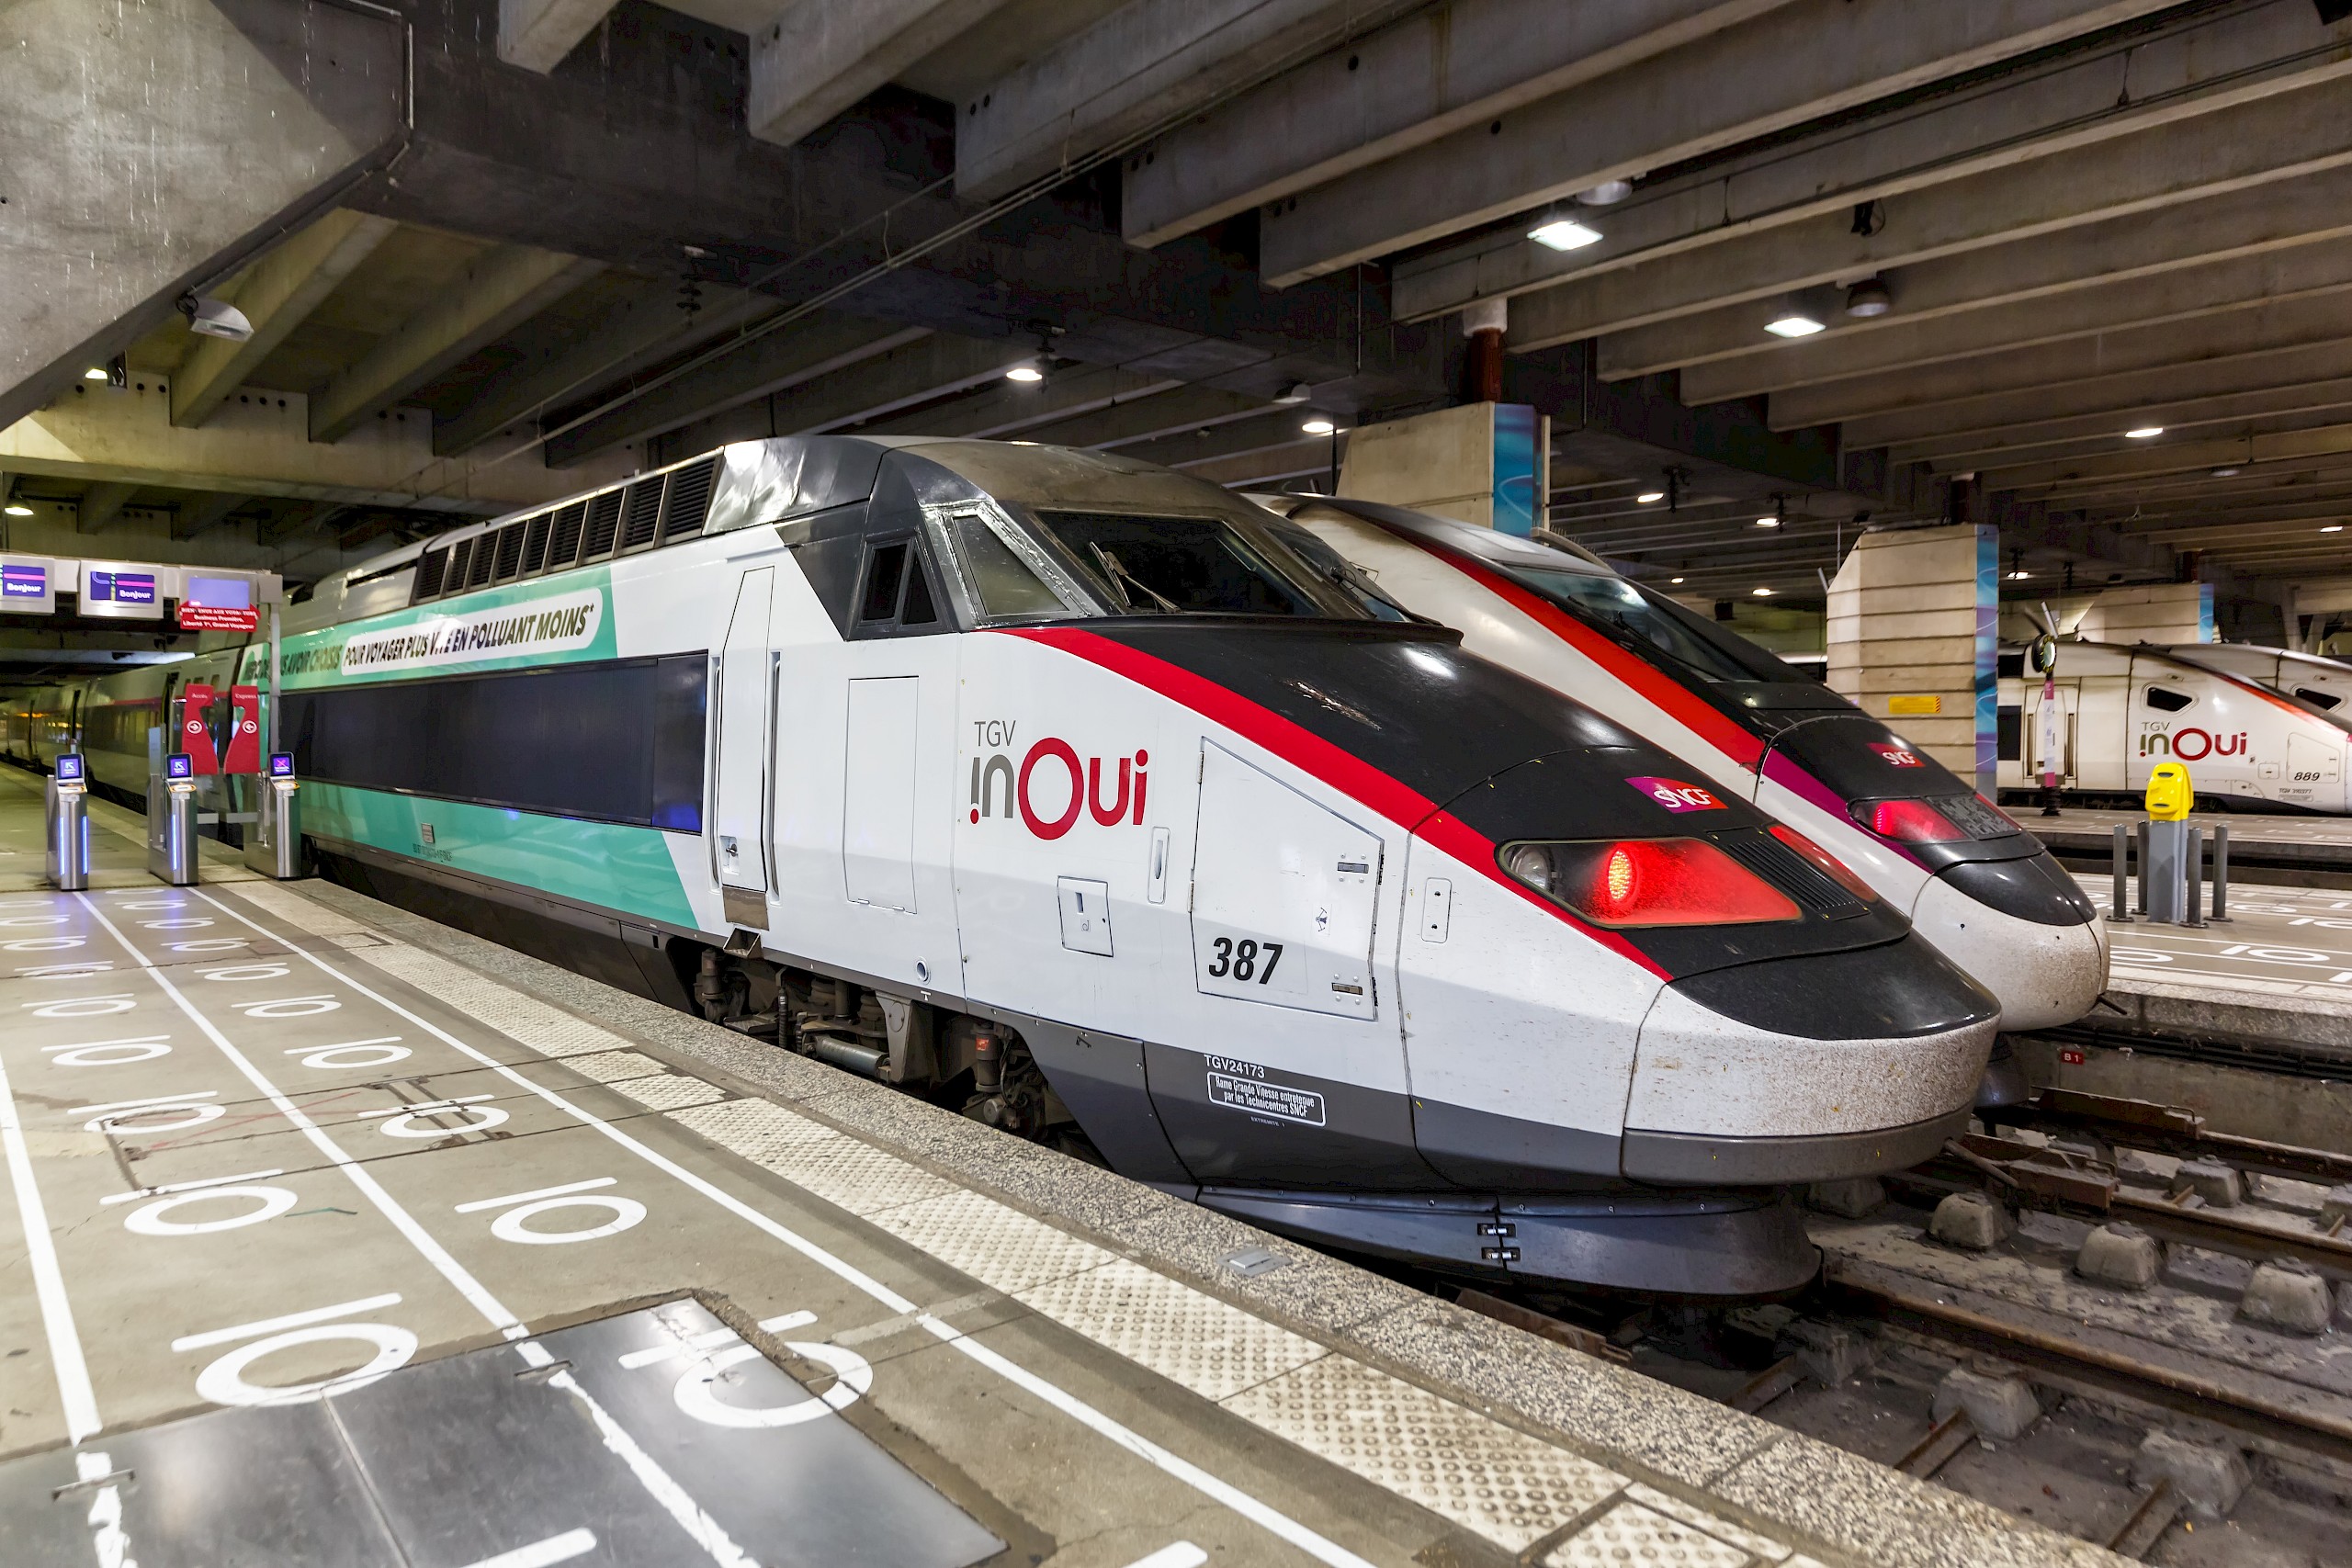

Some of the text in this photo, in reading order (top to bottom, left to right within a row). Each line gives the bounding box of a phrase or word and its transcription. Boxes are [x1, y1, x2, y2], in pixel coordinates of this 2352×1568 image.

[7, 582, 41, 593] Bonjour
[119, 590, 151, 599] Bonjour
[344, 643, 366, 667] POUR
[366, 637, 404, 664] VOYAGER
[405, 632, 429, 660] PLUS
[430, 630, 450, 656] VE
[451, 627, 467, 652] EN
[469, 615, 536, 649] POLLUANT
[974, 720, 1016, 748] TGV
[2141, 722, 2170, 731] TGV
[2294, 772, 2321, 781] 889
[1654, 788, 1712, 808] SNCF
[1208, 937, 1283, 985] 387
[1204, 1054, 1265, 1078] TGV24173
[2064, 1053, 2071, 1061] B
[1216, 1076, 1315, 1108] Rame Grande Vitesse entretenue
[1224, 1091, 1308, 1118] par les Technicentres SNCF
